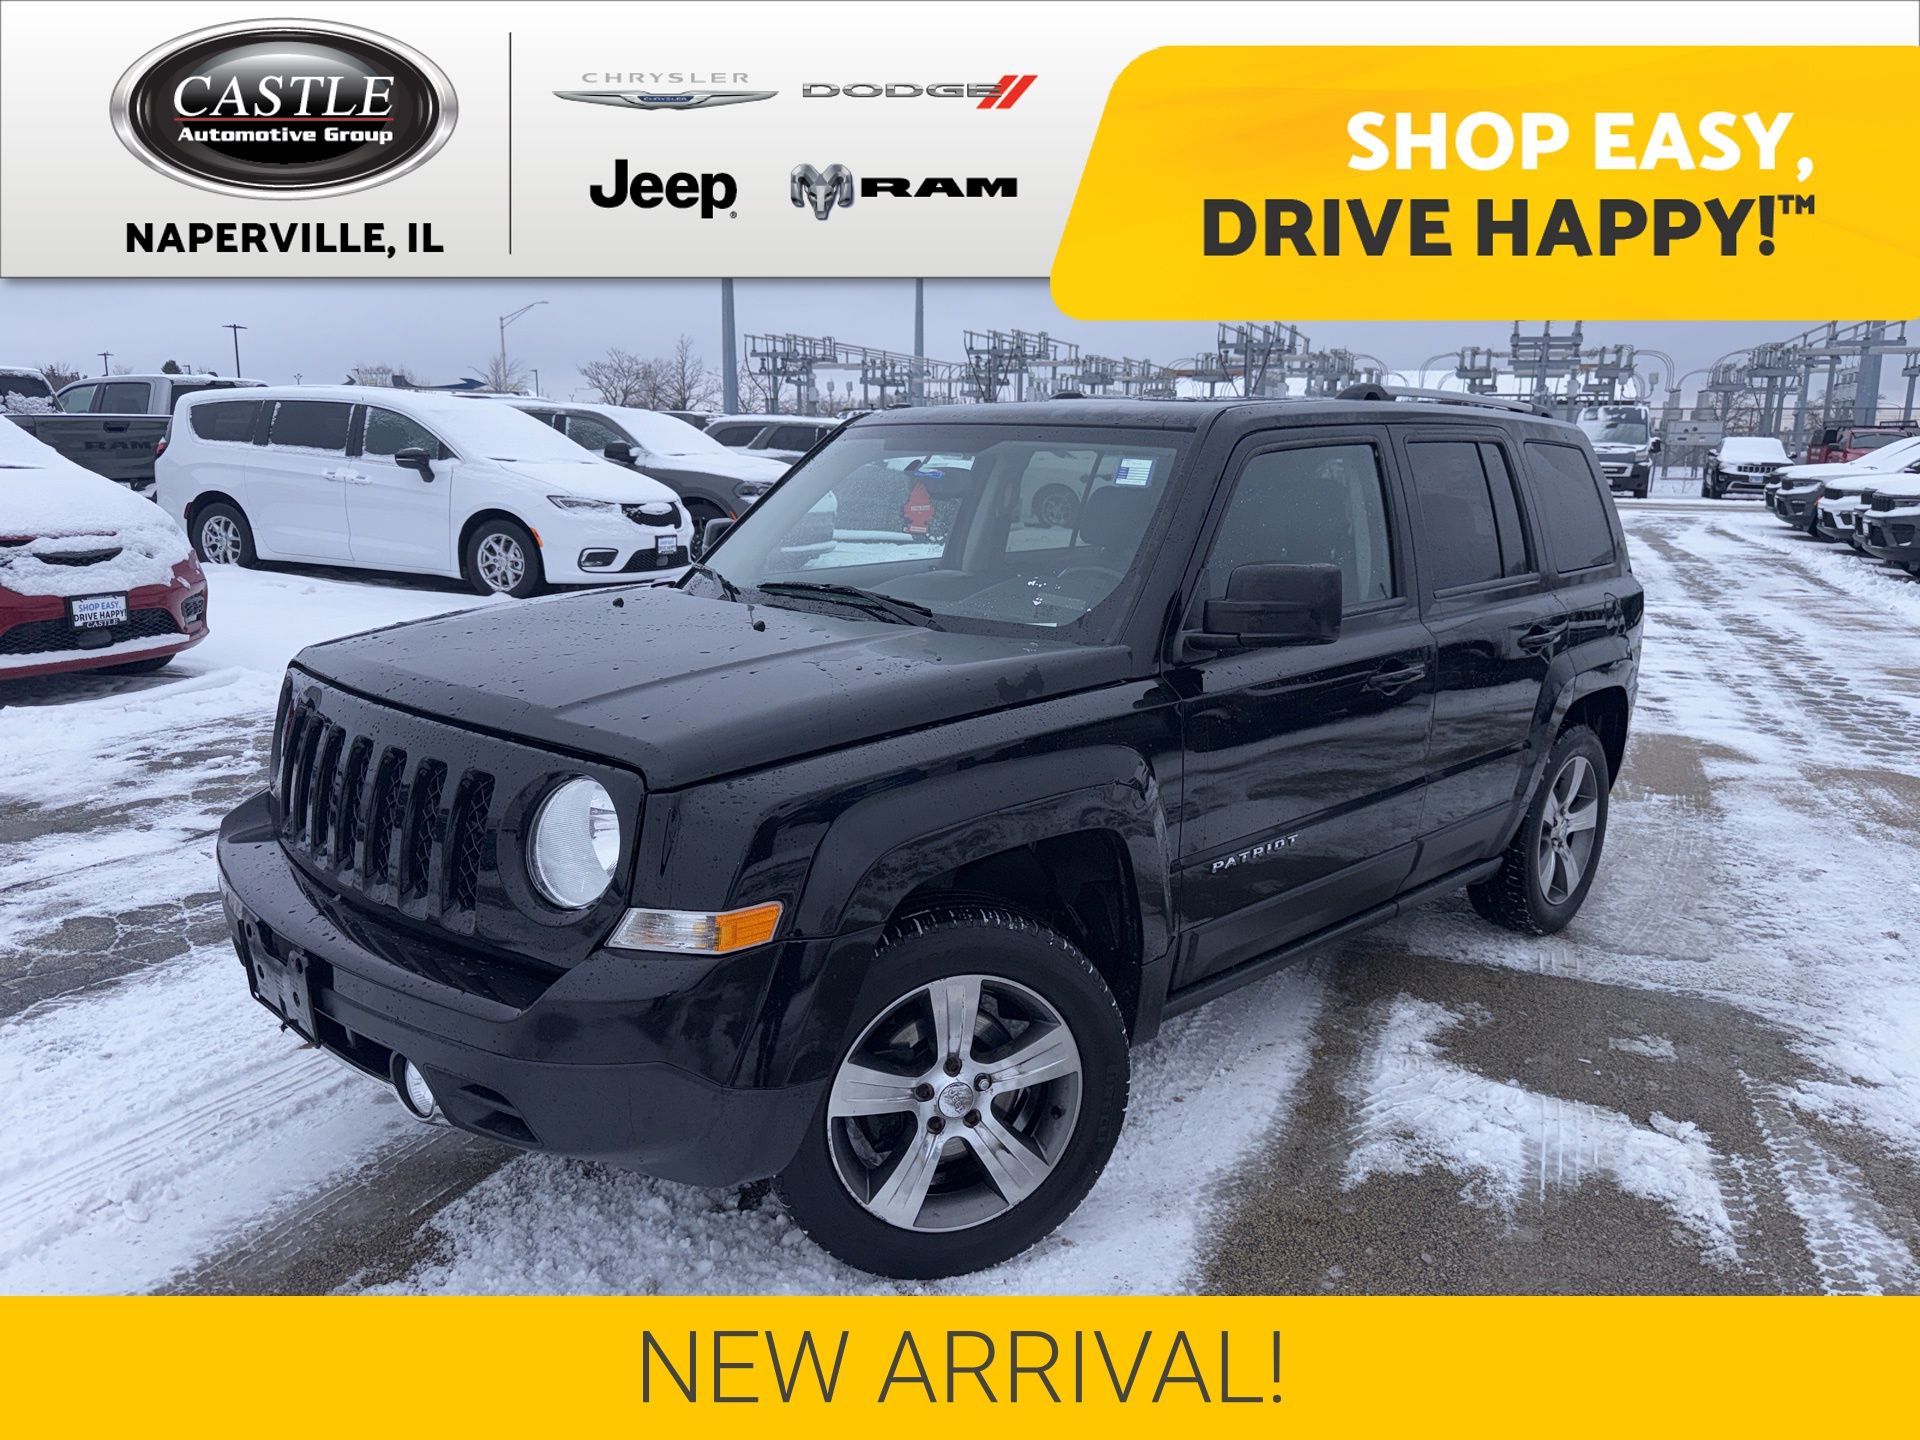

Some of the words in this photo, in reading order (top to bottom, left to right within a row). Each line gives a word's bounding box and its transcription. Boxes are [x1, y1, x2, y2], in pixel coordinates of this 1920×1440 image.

[84, 441, 153, 449] RAM
[78, 602, 100, 612] SHOP
[74, 612, 98, 622] DRIVE
[99, 608, 127, 619] HAPPY!
[86, 618, 118, 629] CASTLE
[1211, 833, 1299, 874] PATRIOT
